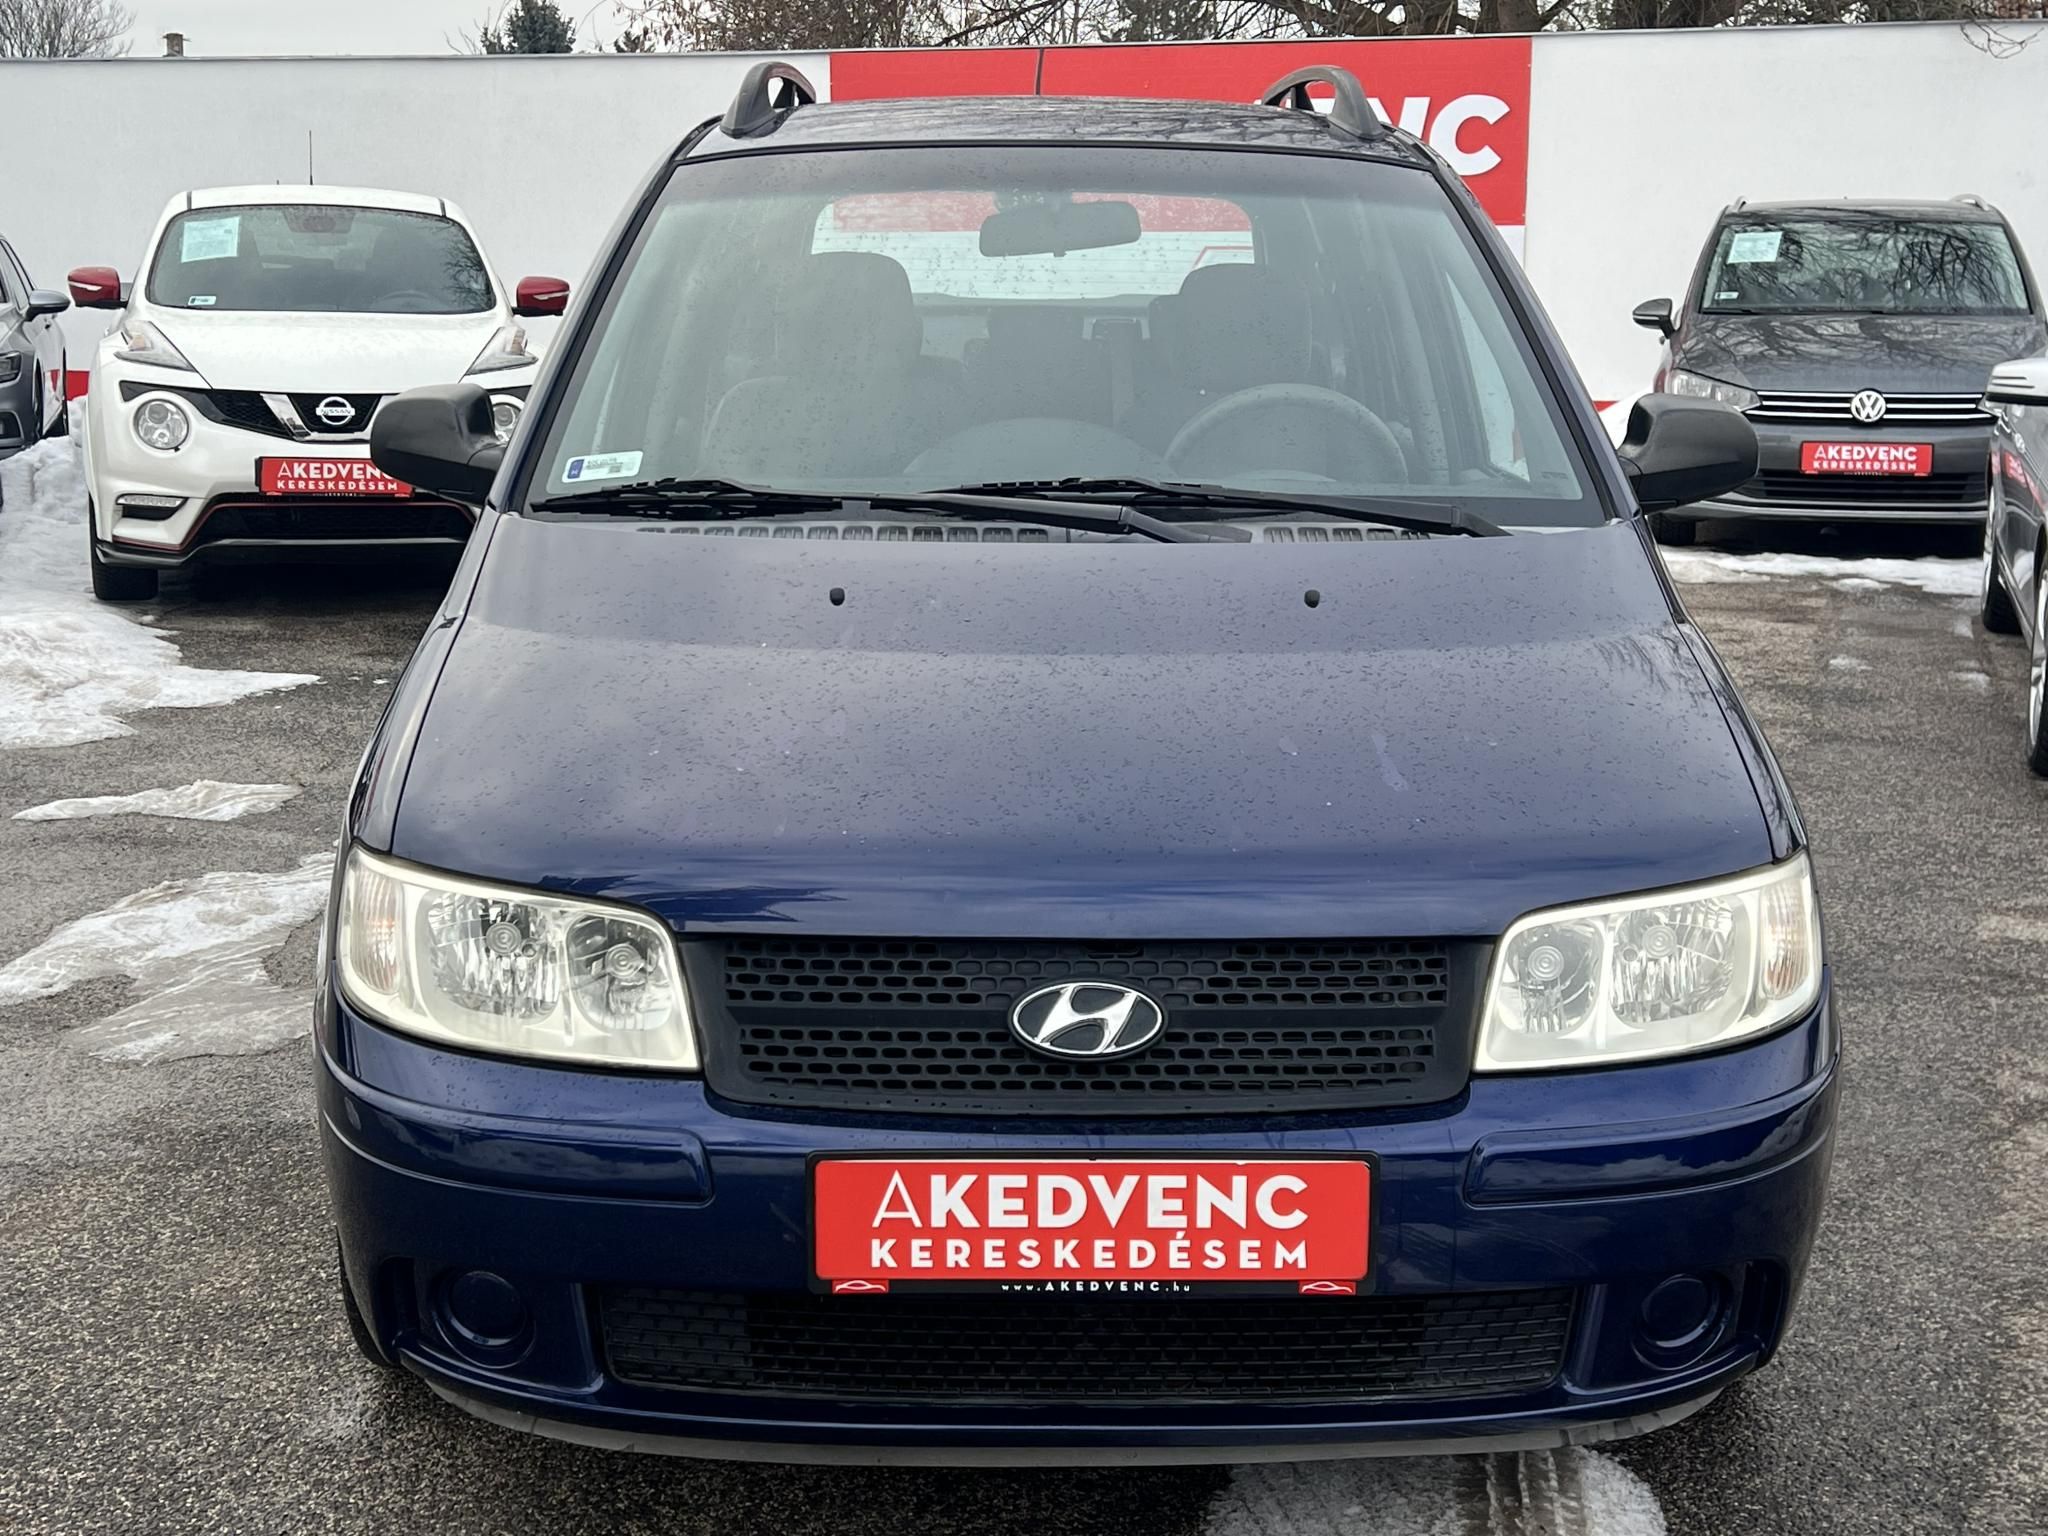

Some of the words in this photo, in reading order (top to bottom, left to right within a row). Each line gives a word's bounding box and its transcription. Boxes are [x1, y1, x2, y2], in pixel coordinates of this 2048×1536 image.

[1814, 445, 1918, 461] AKEDVENC
[1813, 459, 1918, 471] KERESKEDÉSEM
[276, 479, 398, 491] KERESKEDÉSEM
[872, 1169, 1309, 1229] AKEDVENC
[871, 1231, 1308, 1270] KERESKEDÉSEM
[1001, 1281, 1190, 1292] www.AKEDVENC.hu
